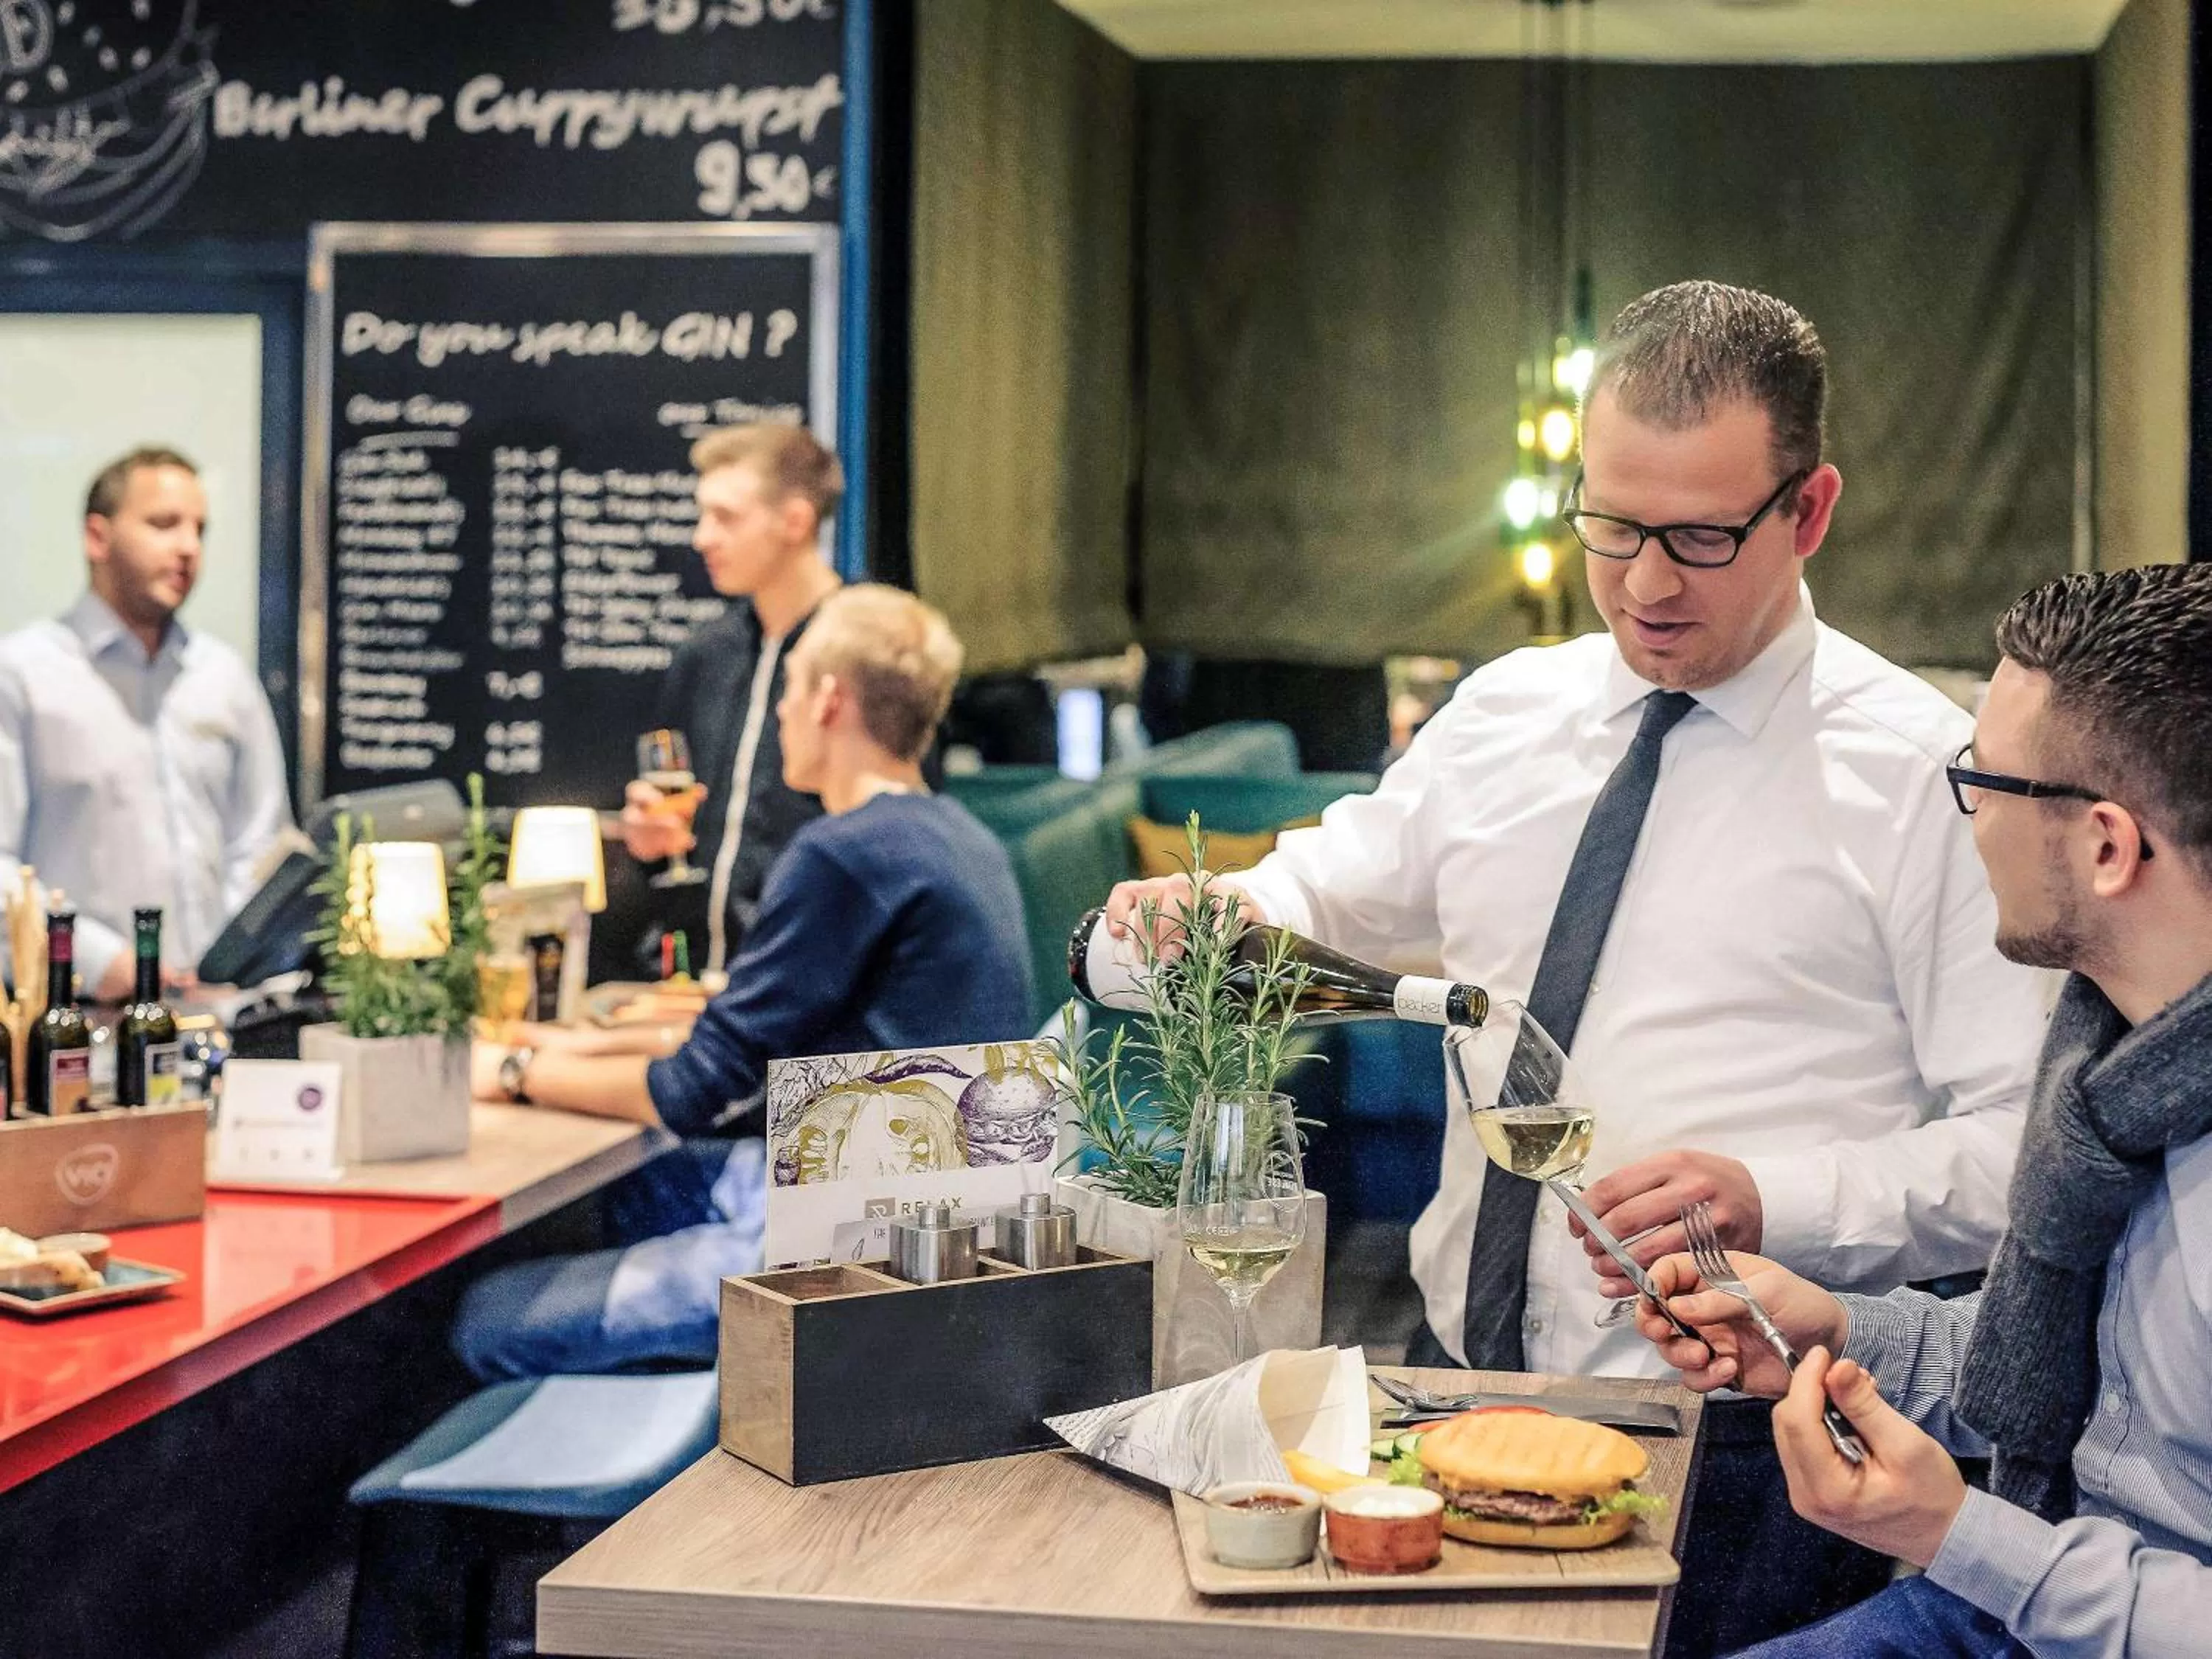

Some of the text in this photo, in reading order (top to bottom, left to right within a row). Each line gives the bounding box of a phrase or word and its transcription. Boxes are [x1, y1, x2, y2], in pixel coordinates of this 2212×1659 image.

[214, 74, 841, 147] Berliner Currywurst
[341, 311, 414, 355] Do
[416, 322, 514, 366] you
[512, 310, 658, 366] speak
[662, 311, 753, 361] GIN
